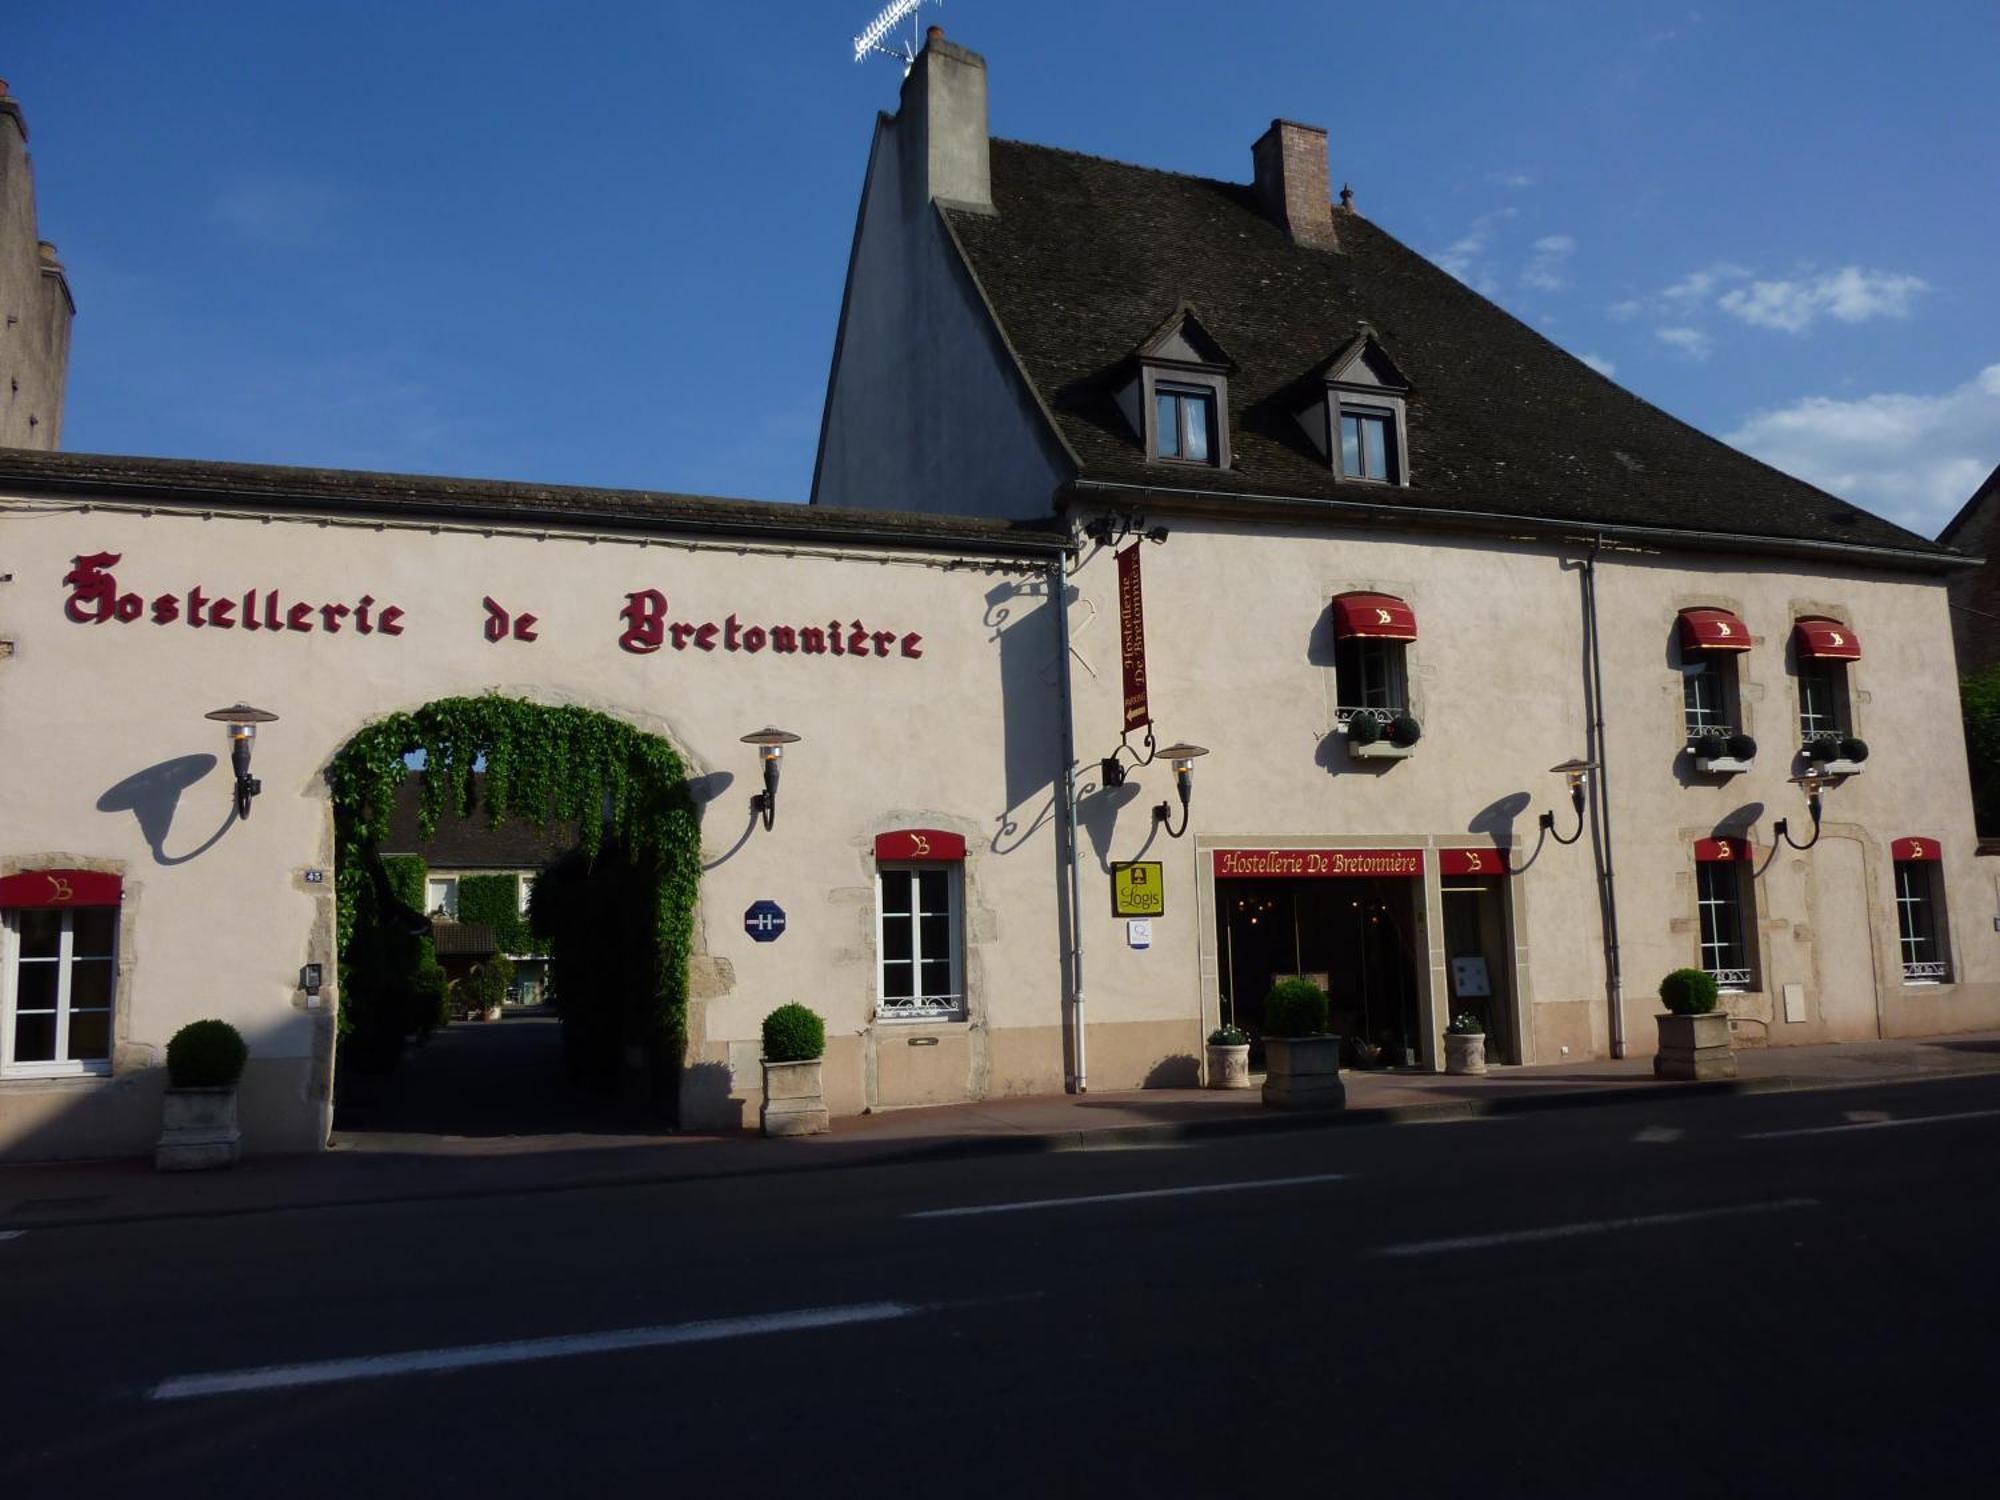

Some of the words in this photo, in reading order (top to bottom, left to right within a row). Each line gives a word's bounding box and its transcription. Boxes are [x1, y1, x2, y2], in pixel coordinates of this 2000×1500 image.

[63, 551, 405, 636] Hostellerie
[483, 596, 539, 643] de
[619, 588, 924, 660] Bretonnière
[1121, 577, 1134, 669] Hostellerie
[1134, 660, 1145, 686] De
[1221, 851, 1303, 873] Hostellerie
[1307, 853, 1329, 873] De
[1332, 853, 1417, 873] Bretonnière
[1120, 885, 1160, 910] Logis
[758, 914, 773, 930] H
